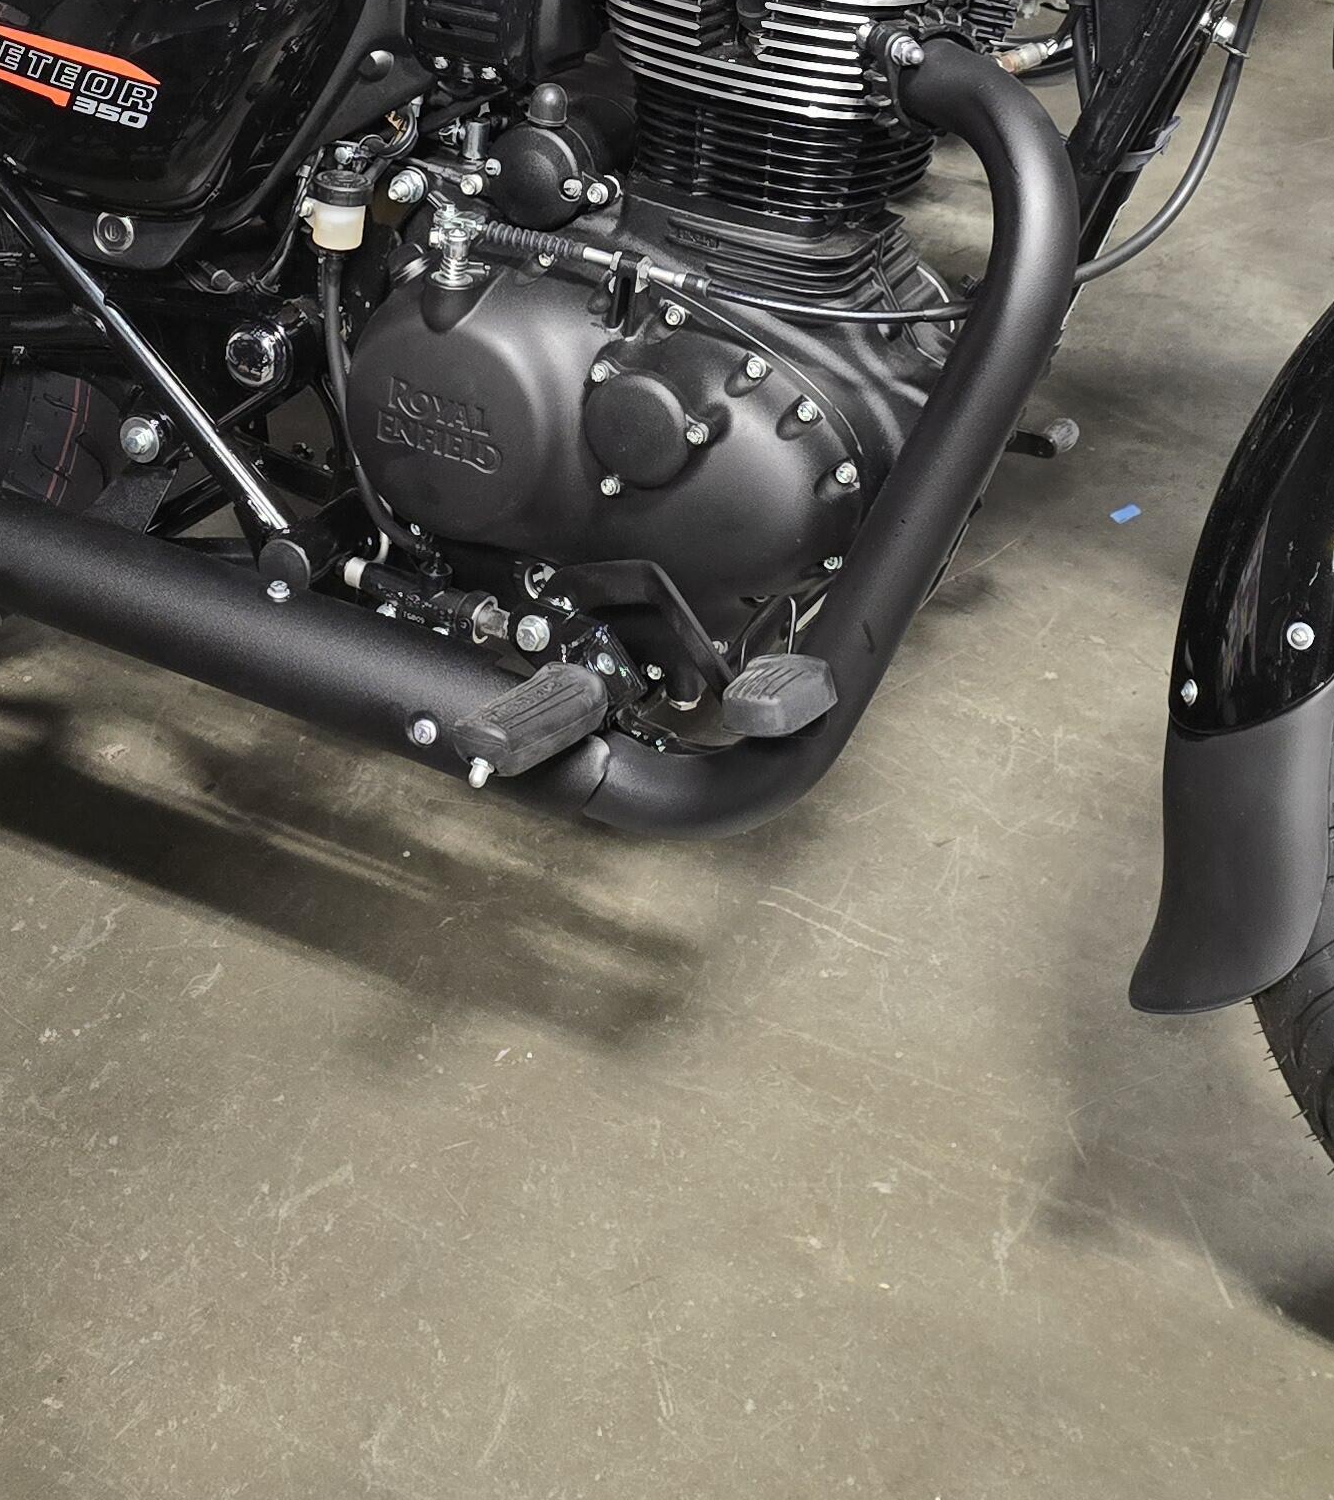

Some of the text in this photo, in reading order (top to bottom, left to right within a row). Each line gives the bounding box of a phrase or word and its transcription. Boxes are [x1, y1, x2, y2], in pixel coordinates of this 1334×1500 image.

[72, 95, 148, 129] 350
[387, 376, 491, 437] ROYAL
[376, 410, 504, 475] ENFIELD
